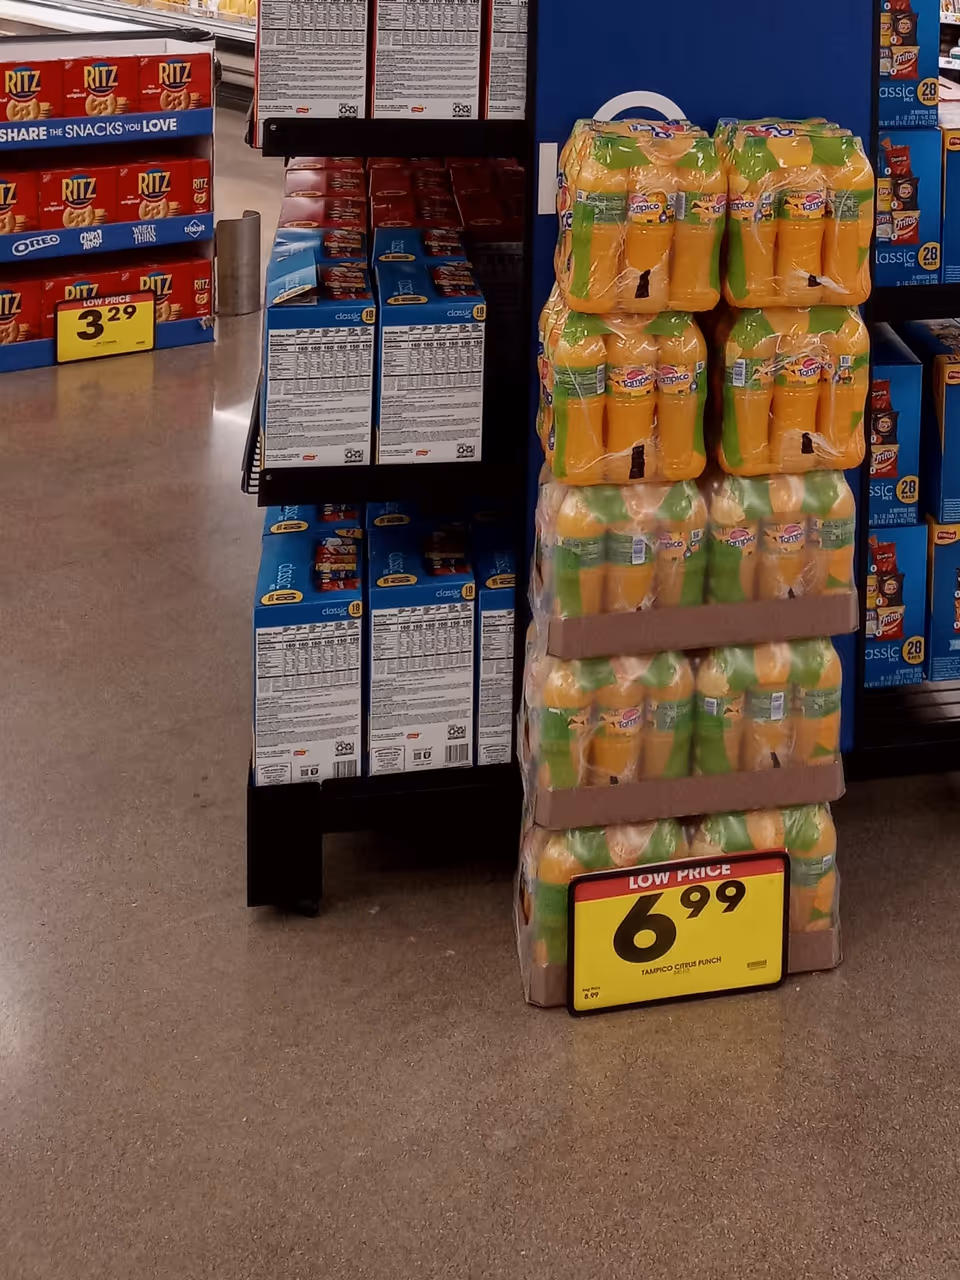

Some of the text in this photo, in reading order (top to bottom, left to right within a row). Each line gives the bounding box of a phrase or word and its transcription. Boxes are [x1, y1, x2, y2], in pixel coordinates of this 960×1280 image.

[83, 65, 118, 89] RITZ
[158, 62, 192, 85] RITZ
[5, 70, 41, 94] RITZ
[921, 82, 937, 96] 28
[879, 84, 914, 98] assic
[0, 118, 178, 143] SHARE THE SNACKS YOU LOVE
[61, 177, 97, 202] RITZ
[138, 171, 171, 198] RITZ
[193, 177, 208, 189] RITZ
[0, 183, 17, 205] TZ
[801, 198, 827, 212] Tampi
[132, 225, 156, 234] WHEAT
[12, 235, 60, 255] OREO
[133, 233, 156, 245] THINS
[875, 249, 916, 264] lassic
[923, 246, 938, 260] 28
[194, 278, 209, 291] RITZ
[0, 292, 21, 318] ITZ
[83, 295, 131, 307] LOW PRICE
[335, 312, 360, 321] classic
[446, 309, 472, 318] classic
[869, 483, 893, 497] ssic
[901, 480, 915, 495] 28
[725, 535, 757, 547] Tampic
[779, 530, 805, 544] Tampi
[436, 588, 461, 598] classic
[322, 607, 347, 616] classic
[351, 604, 360, 614] 18
[865, 644, 900, 659] assic
[907, 640, 922, 655] 28
[629, 865, 730, 890] LOW PRICE
[641, 963, 674, 976] TAMPICO
[674, 960, 698, 971] CITRUS
[698, 956, 722, 967] PUNCH
[584, 991, 600, 1000] 8.99
